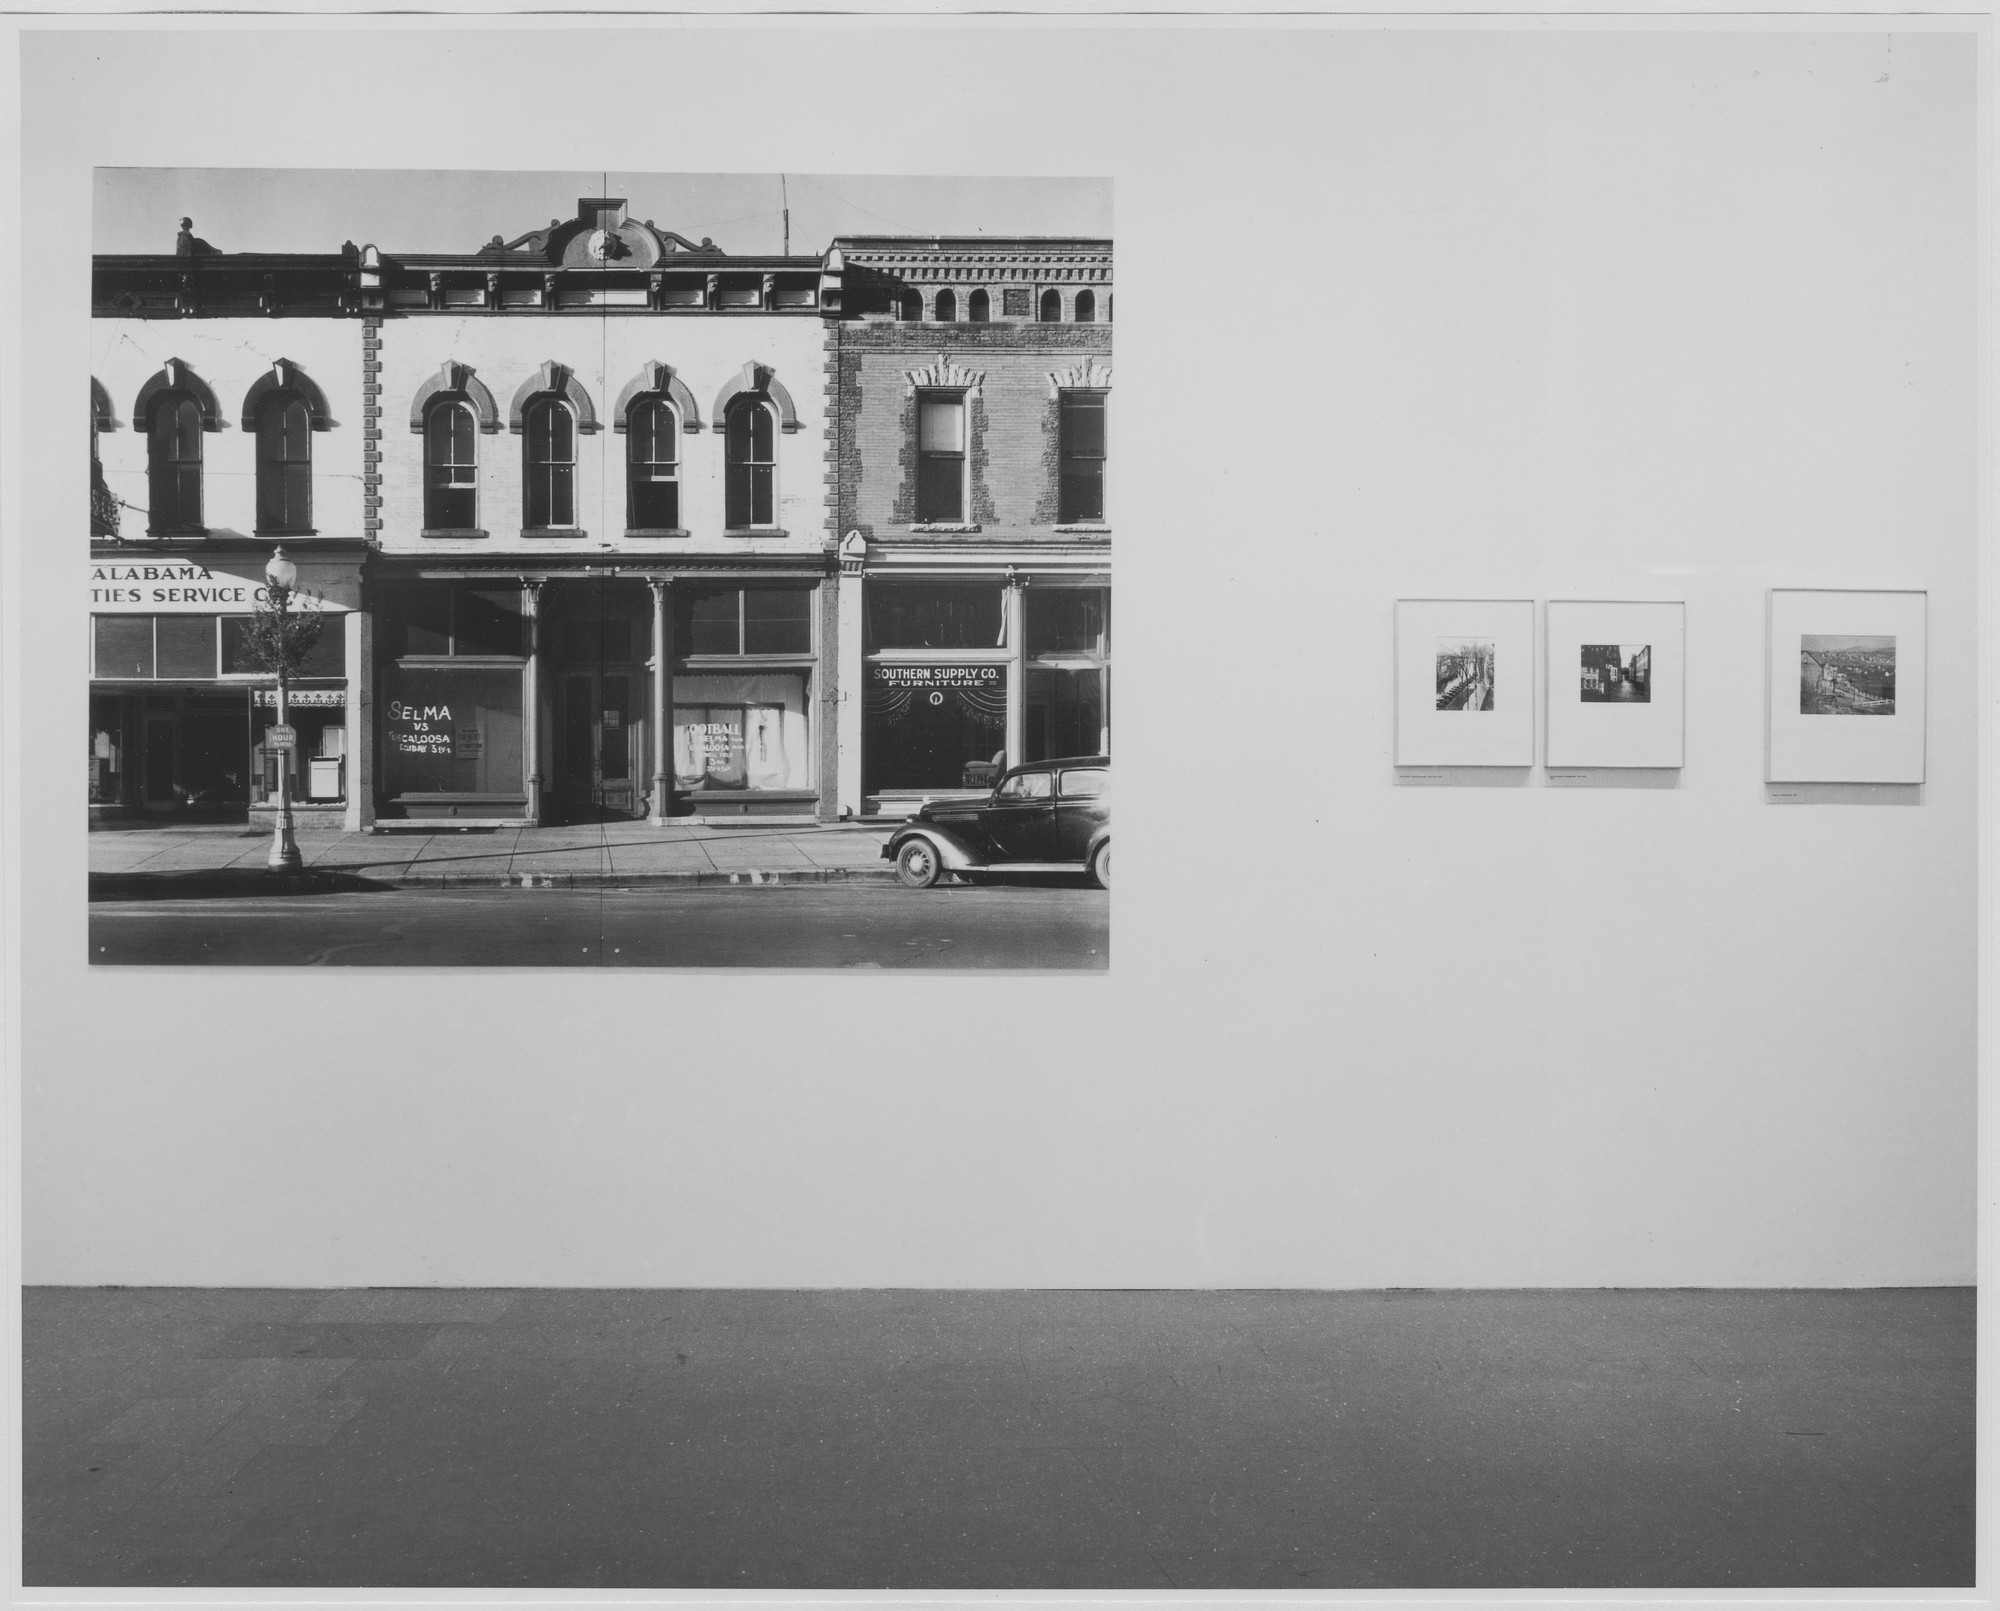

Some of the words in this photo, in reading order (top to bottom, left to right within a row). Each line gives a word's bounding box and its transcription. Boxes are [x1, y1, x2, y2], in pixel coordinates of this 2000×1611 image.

[91, 567, 214, 580] ALABAMA
[152, 587, 246, 602] SERVICE
[874, 668, 931, 679] SOUTHERN
[934, 668, 978, 679] SUPPLY
[980, 668, 999, 679] CO.
[387, 701, 452, 721] SELMA
[686, 723, 741, 735] OOTBALL
